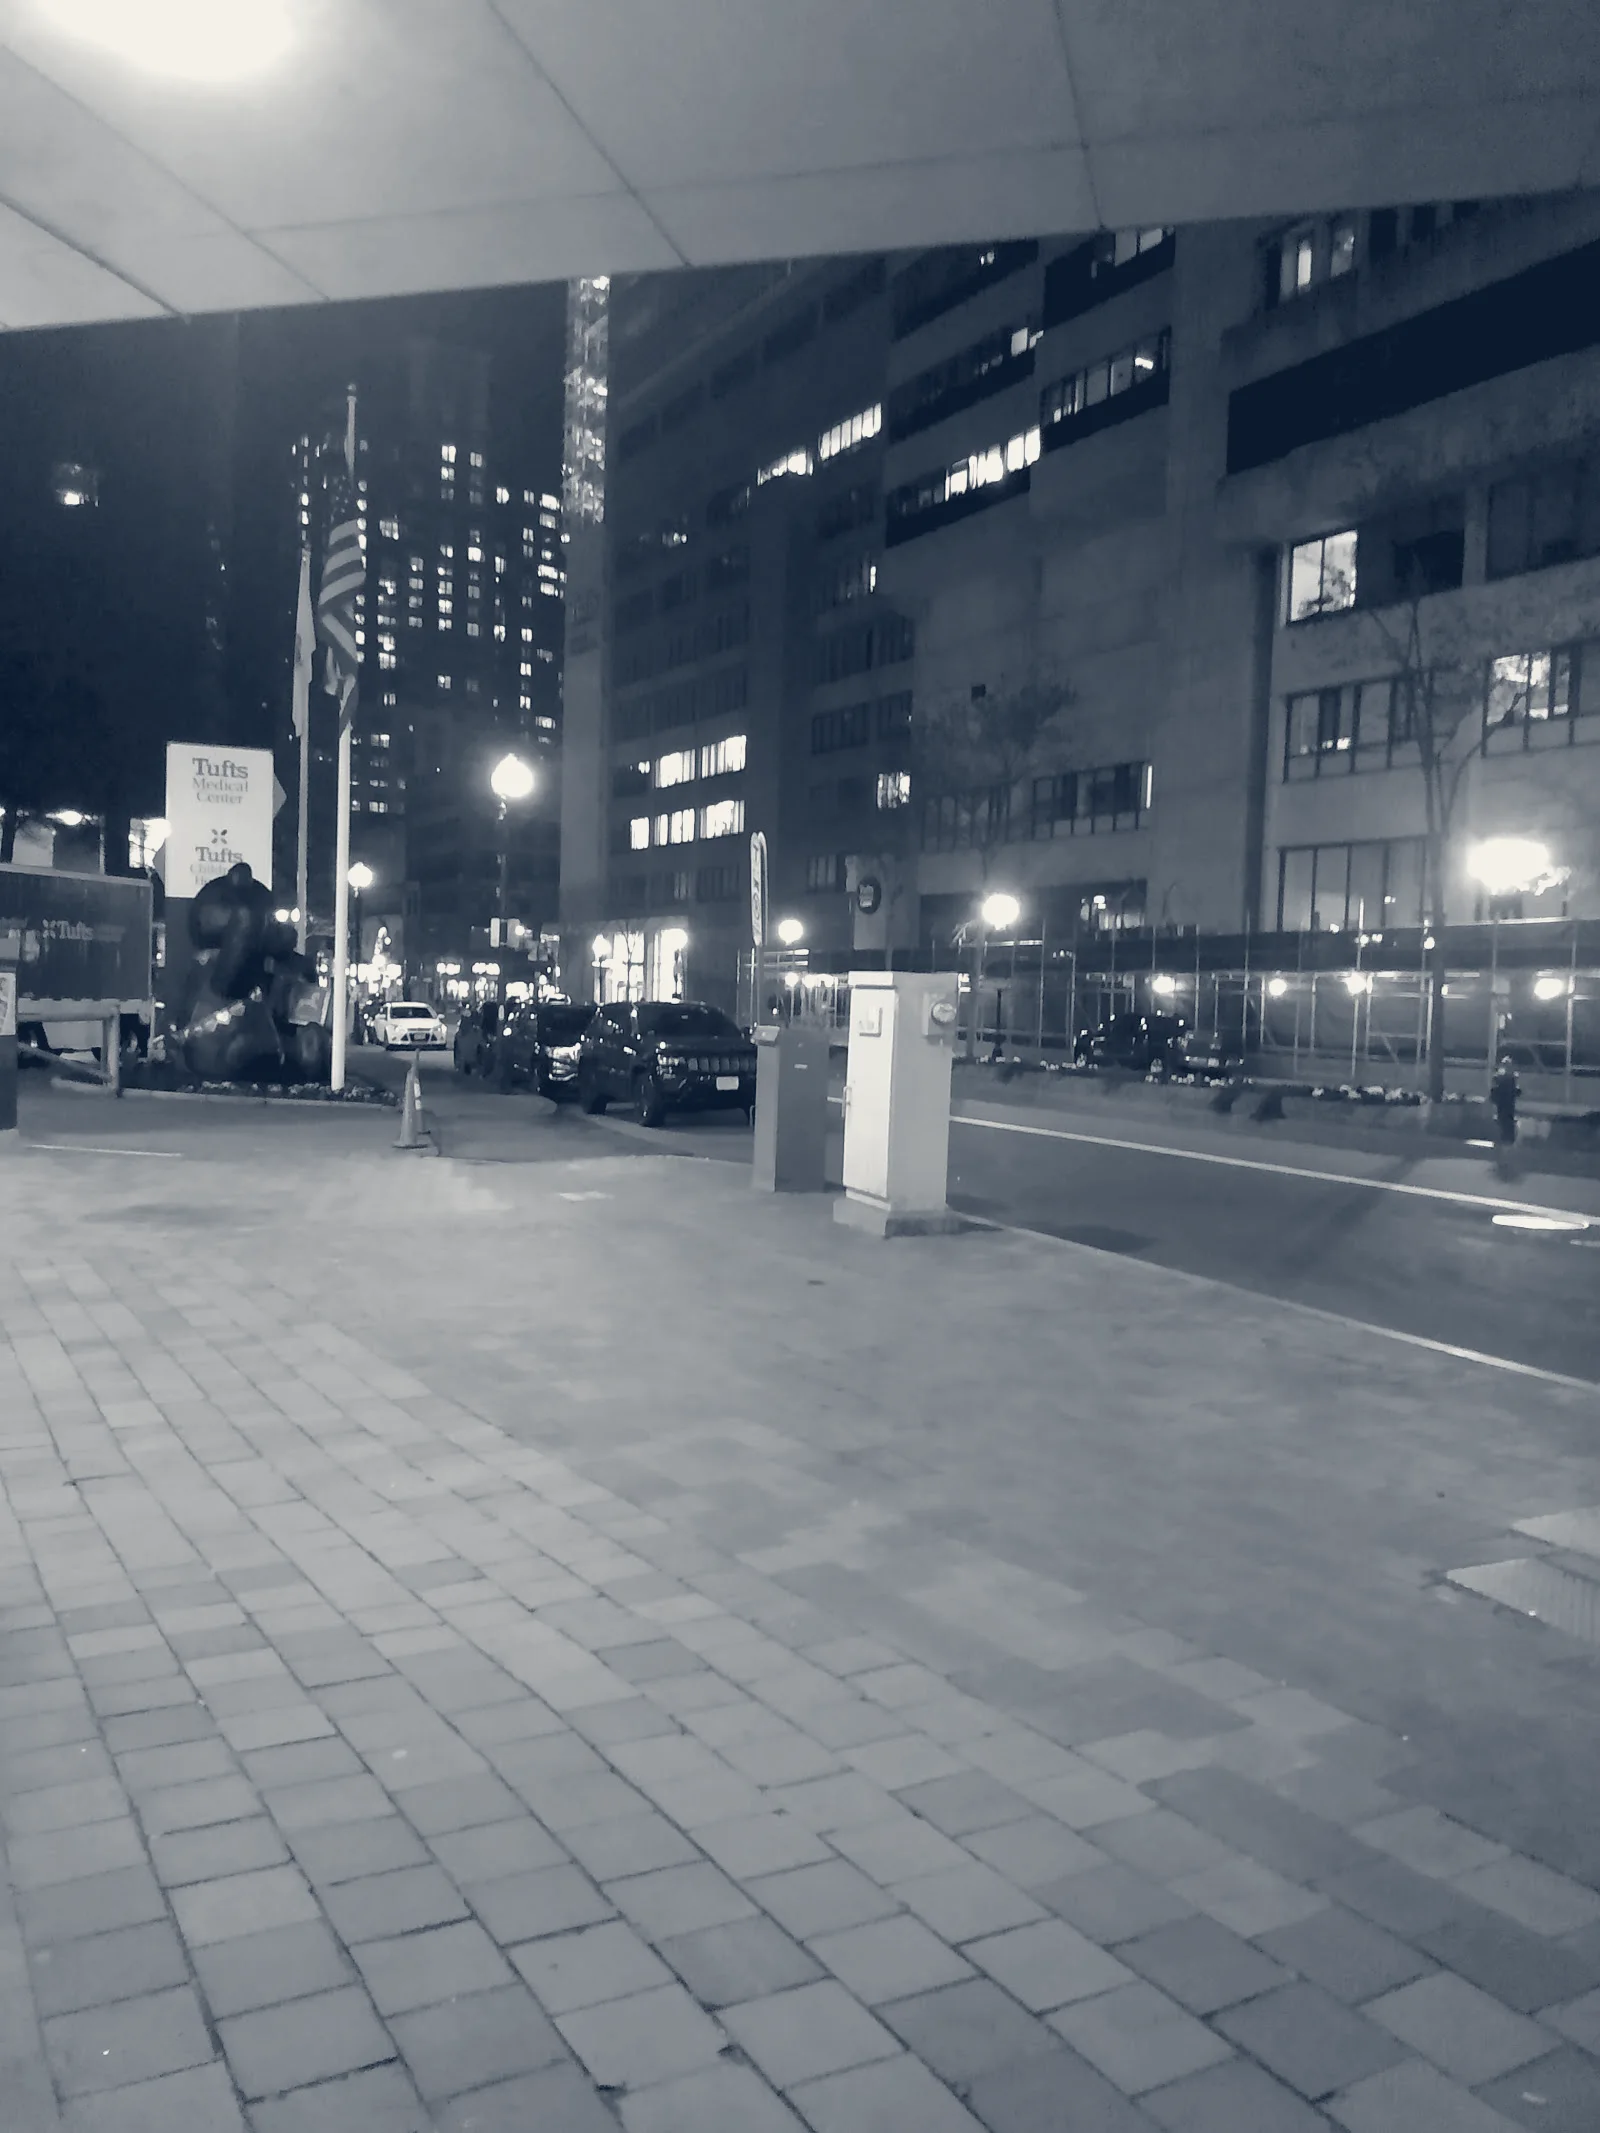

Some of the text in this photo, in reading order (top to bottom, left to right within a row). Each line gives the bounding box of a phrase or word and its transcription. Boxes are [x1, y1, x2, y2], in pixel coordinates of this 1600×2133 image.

[192, 757, 248, 779] Tufts
[192, 778, 248, 793] Medical
[197, 792, 243, 804] Center
[195, 847, 243, 863] Tufts
[56, 920, 93, 940] Tufts
